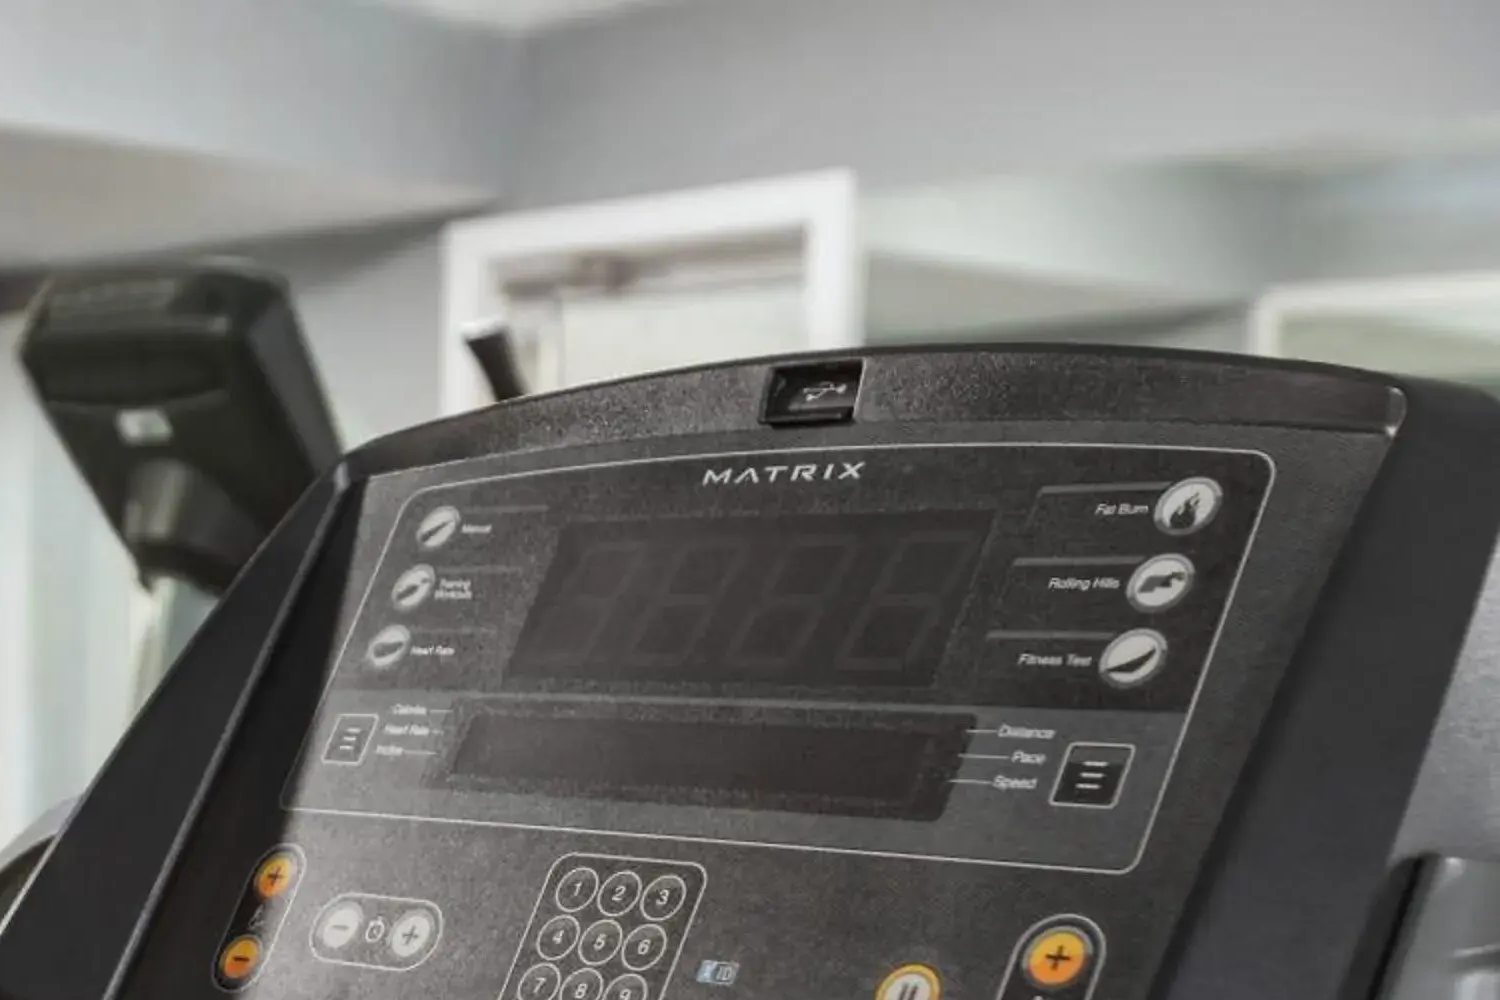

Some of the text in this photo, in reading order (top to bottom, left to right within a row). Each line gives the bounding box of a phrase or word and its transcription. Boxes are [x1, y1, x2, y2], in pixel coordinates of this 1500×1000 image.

[702, 461, 866, 487] MATRIX
[1094, 503, 1149, 516] Fat Burn
[1047, 577, 1121, 592] Rolling Hills
[1017, 653, 1093, 667] Fitness Test
[996, 723, 1057, 740] Distance
[1011, 750, 1047, 766] Pace
[992, 774, 1038, 793] Speed
[572, 881, 670, 906] 1 2 3
[552, 929, 652, 956] 4 5 6
[533, 976, 547, 994] 7
[574, 983, 589, 999] 8
